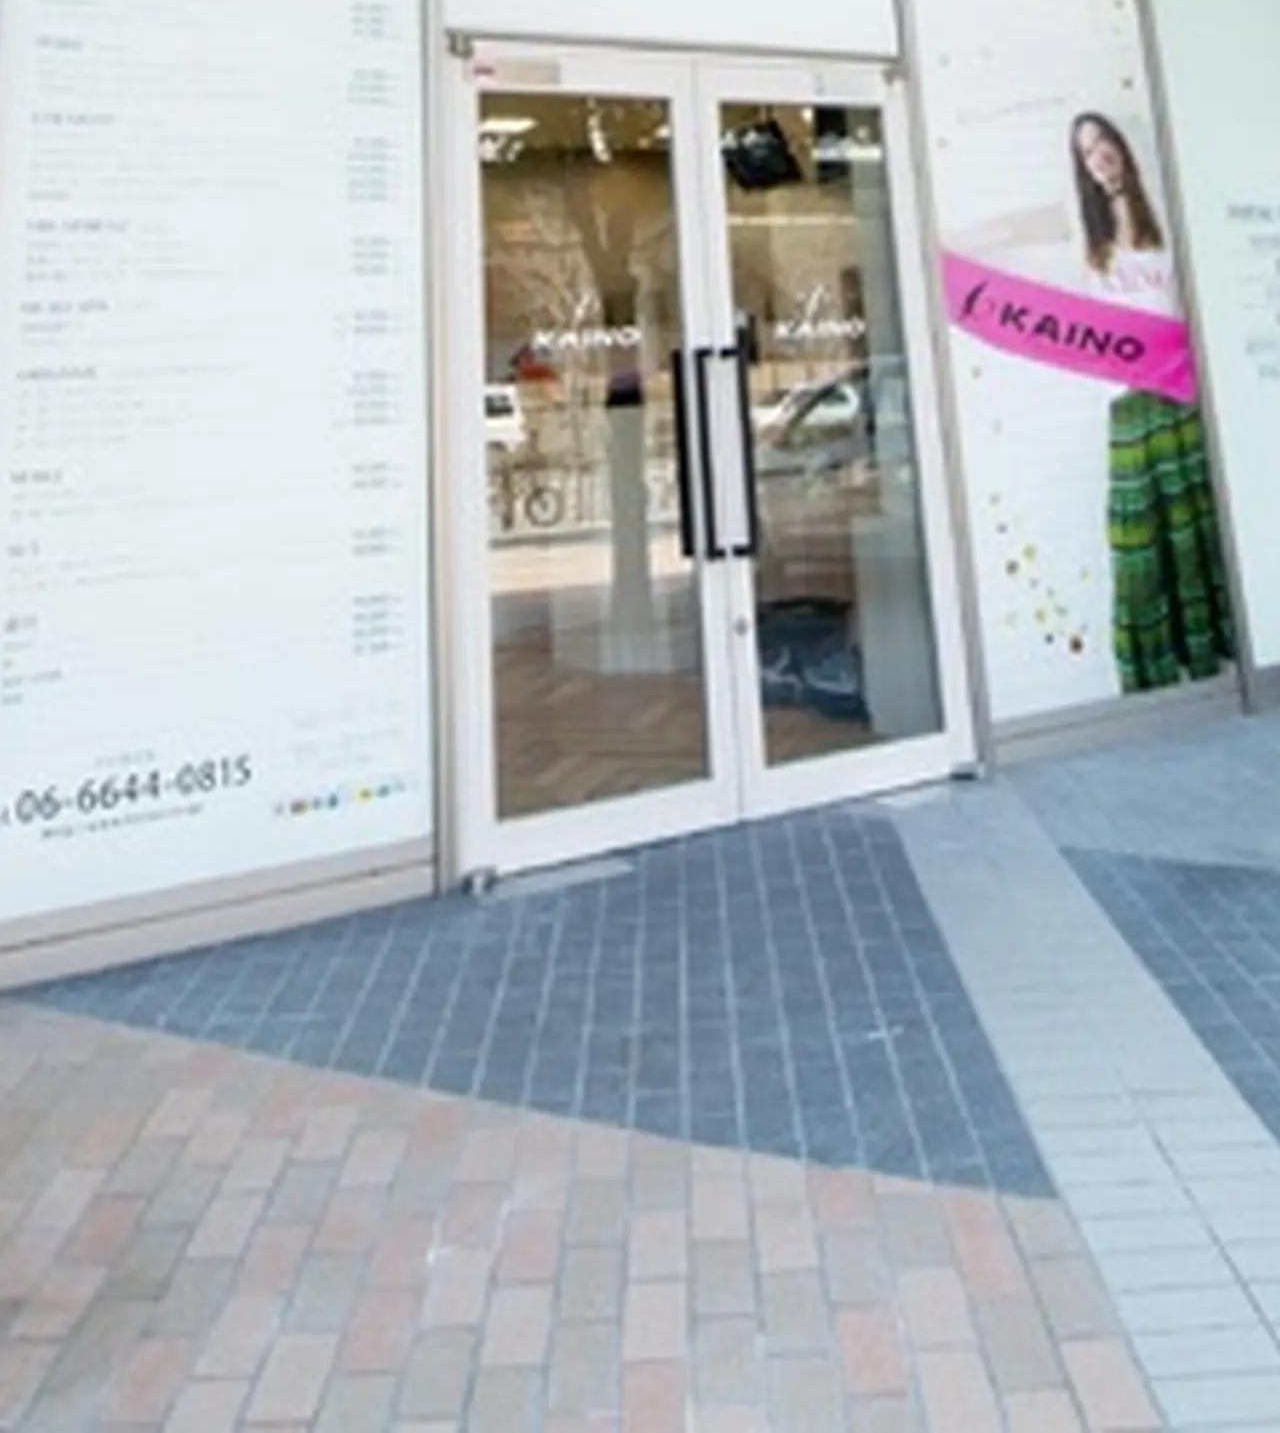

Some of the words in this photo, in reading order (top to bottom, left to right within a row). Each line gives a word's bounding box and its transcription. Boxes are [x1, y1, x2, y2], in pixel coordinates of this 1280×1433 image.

[532, 326, 643, 352] KAINO
[772, 317, 867, 341] KAINO
[999, 303, 1146, 365] KAINO
[15, 751, 253, 825] 06-6644-0815
